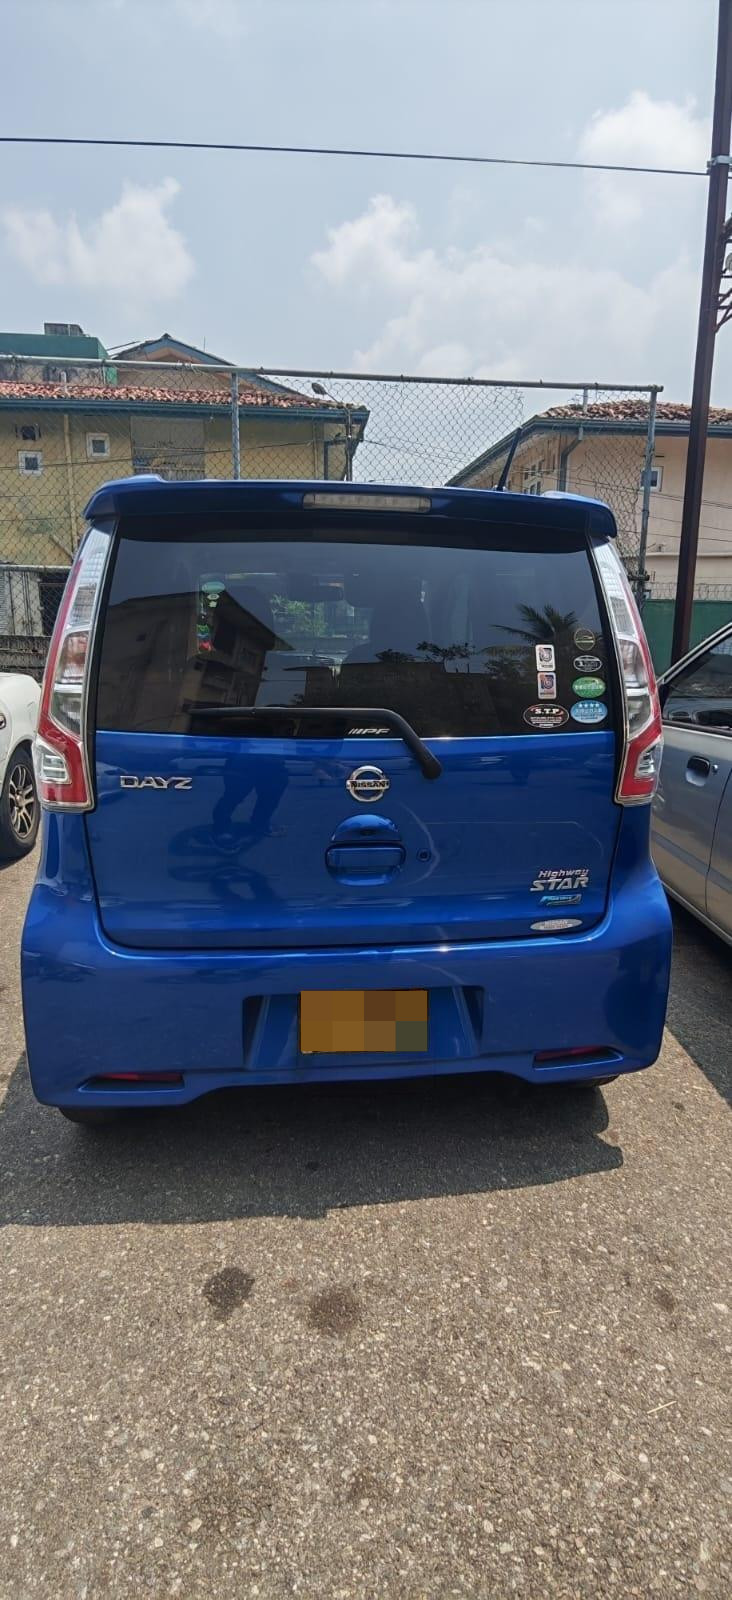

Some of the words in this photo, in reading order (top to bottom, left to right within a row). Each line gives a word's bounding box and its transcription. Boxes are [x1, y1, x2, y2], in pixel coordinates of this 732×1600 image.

[119, 775, 193, 790] DAYZ
[350, 780, 386, 788] NISSAN
[538, 869, 589, 879] Highway
[530, 877, 589, 892] STAR
